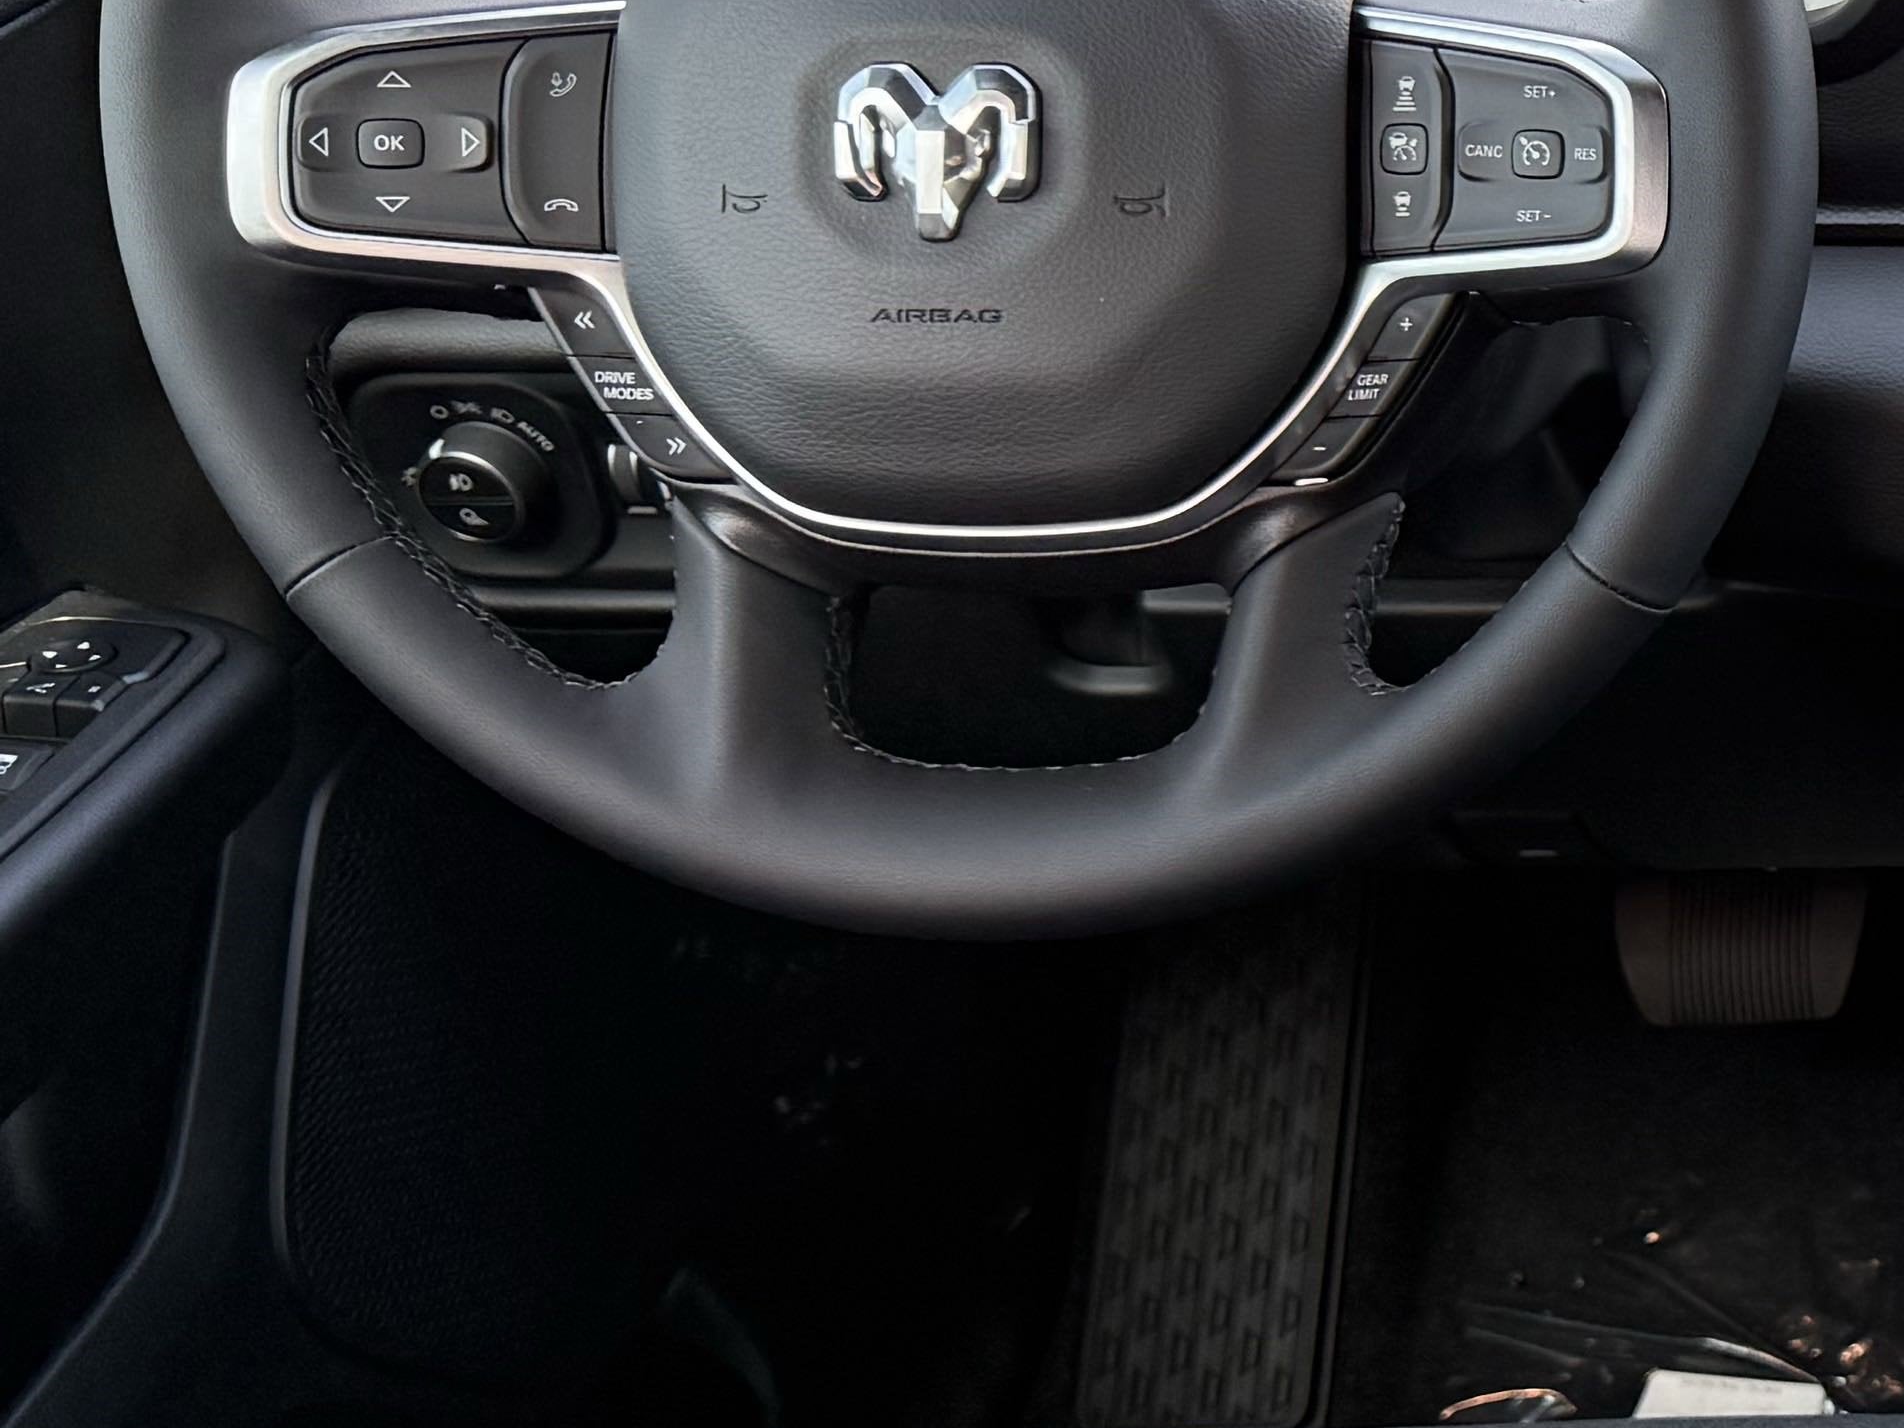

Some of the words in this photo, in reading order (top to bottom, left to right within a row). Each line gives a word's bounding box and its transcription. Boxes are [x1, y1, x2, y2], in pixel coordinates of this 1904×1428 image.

[373, 134, 405, 151] OK
[1464, 144, 1503, 158] CANC
[1574, 148, 1597, 161] RES
[870, 307, 1004, 323] AIRBAG
[594, 370, 636, 385] DRIVE
[1356, 373, 1389, 387] GEAR
[603, 386, 655, 401] MODES
[1347, 387, 1380, 401] LIMIT
[516, 421, 555, 452] AUTO
